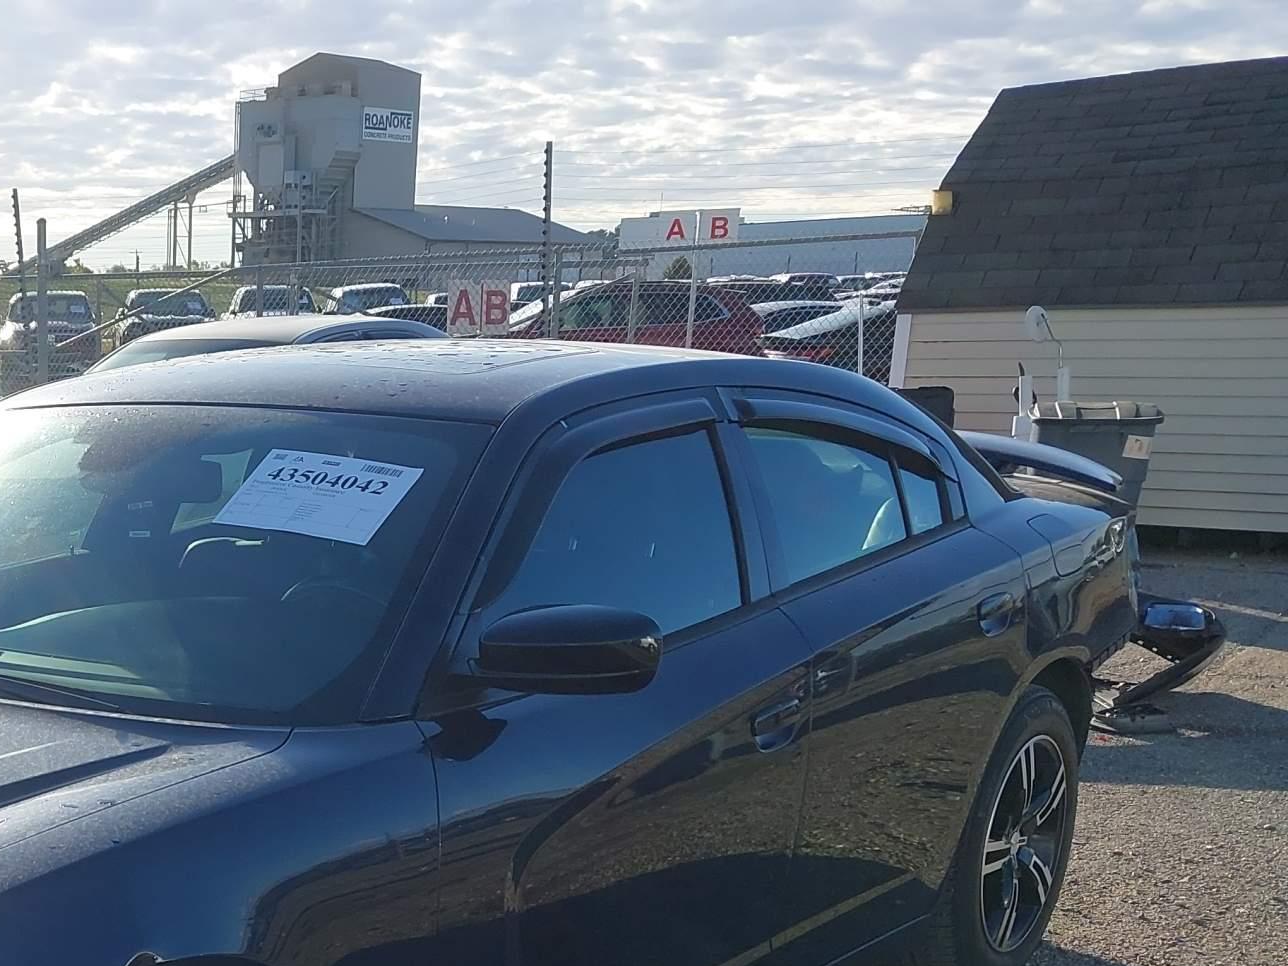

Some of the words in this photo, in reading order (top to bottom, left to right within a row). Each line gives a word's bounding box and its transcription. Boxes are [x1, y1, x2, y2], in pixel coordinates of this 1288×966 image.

[364, 112, 412, 130] ROANOKE
[666, 218, 686, 241] A
[710, 217, 729, 239] B
[267, 467, 389, 495] 43504042
